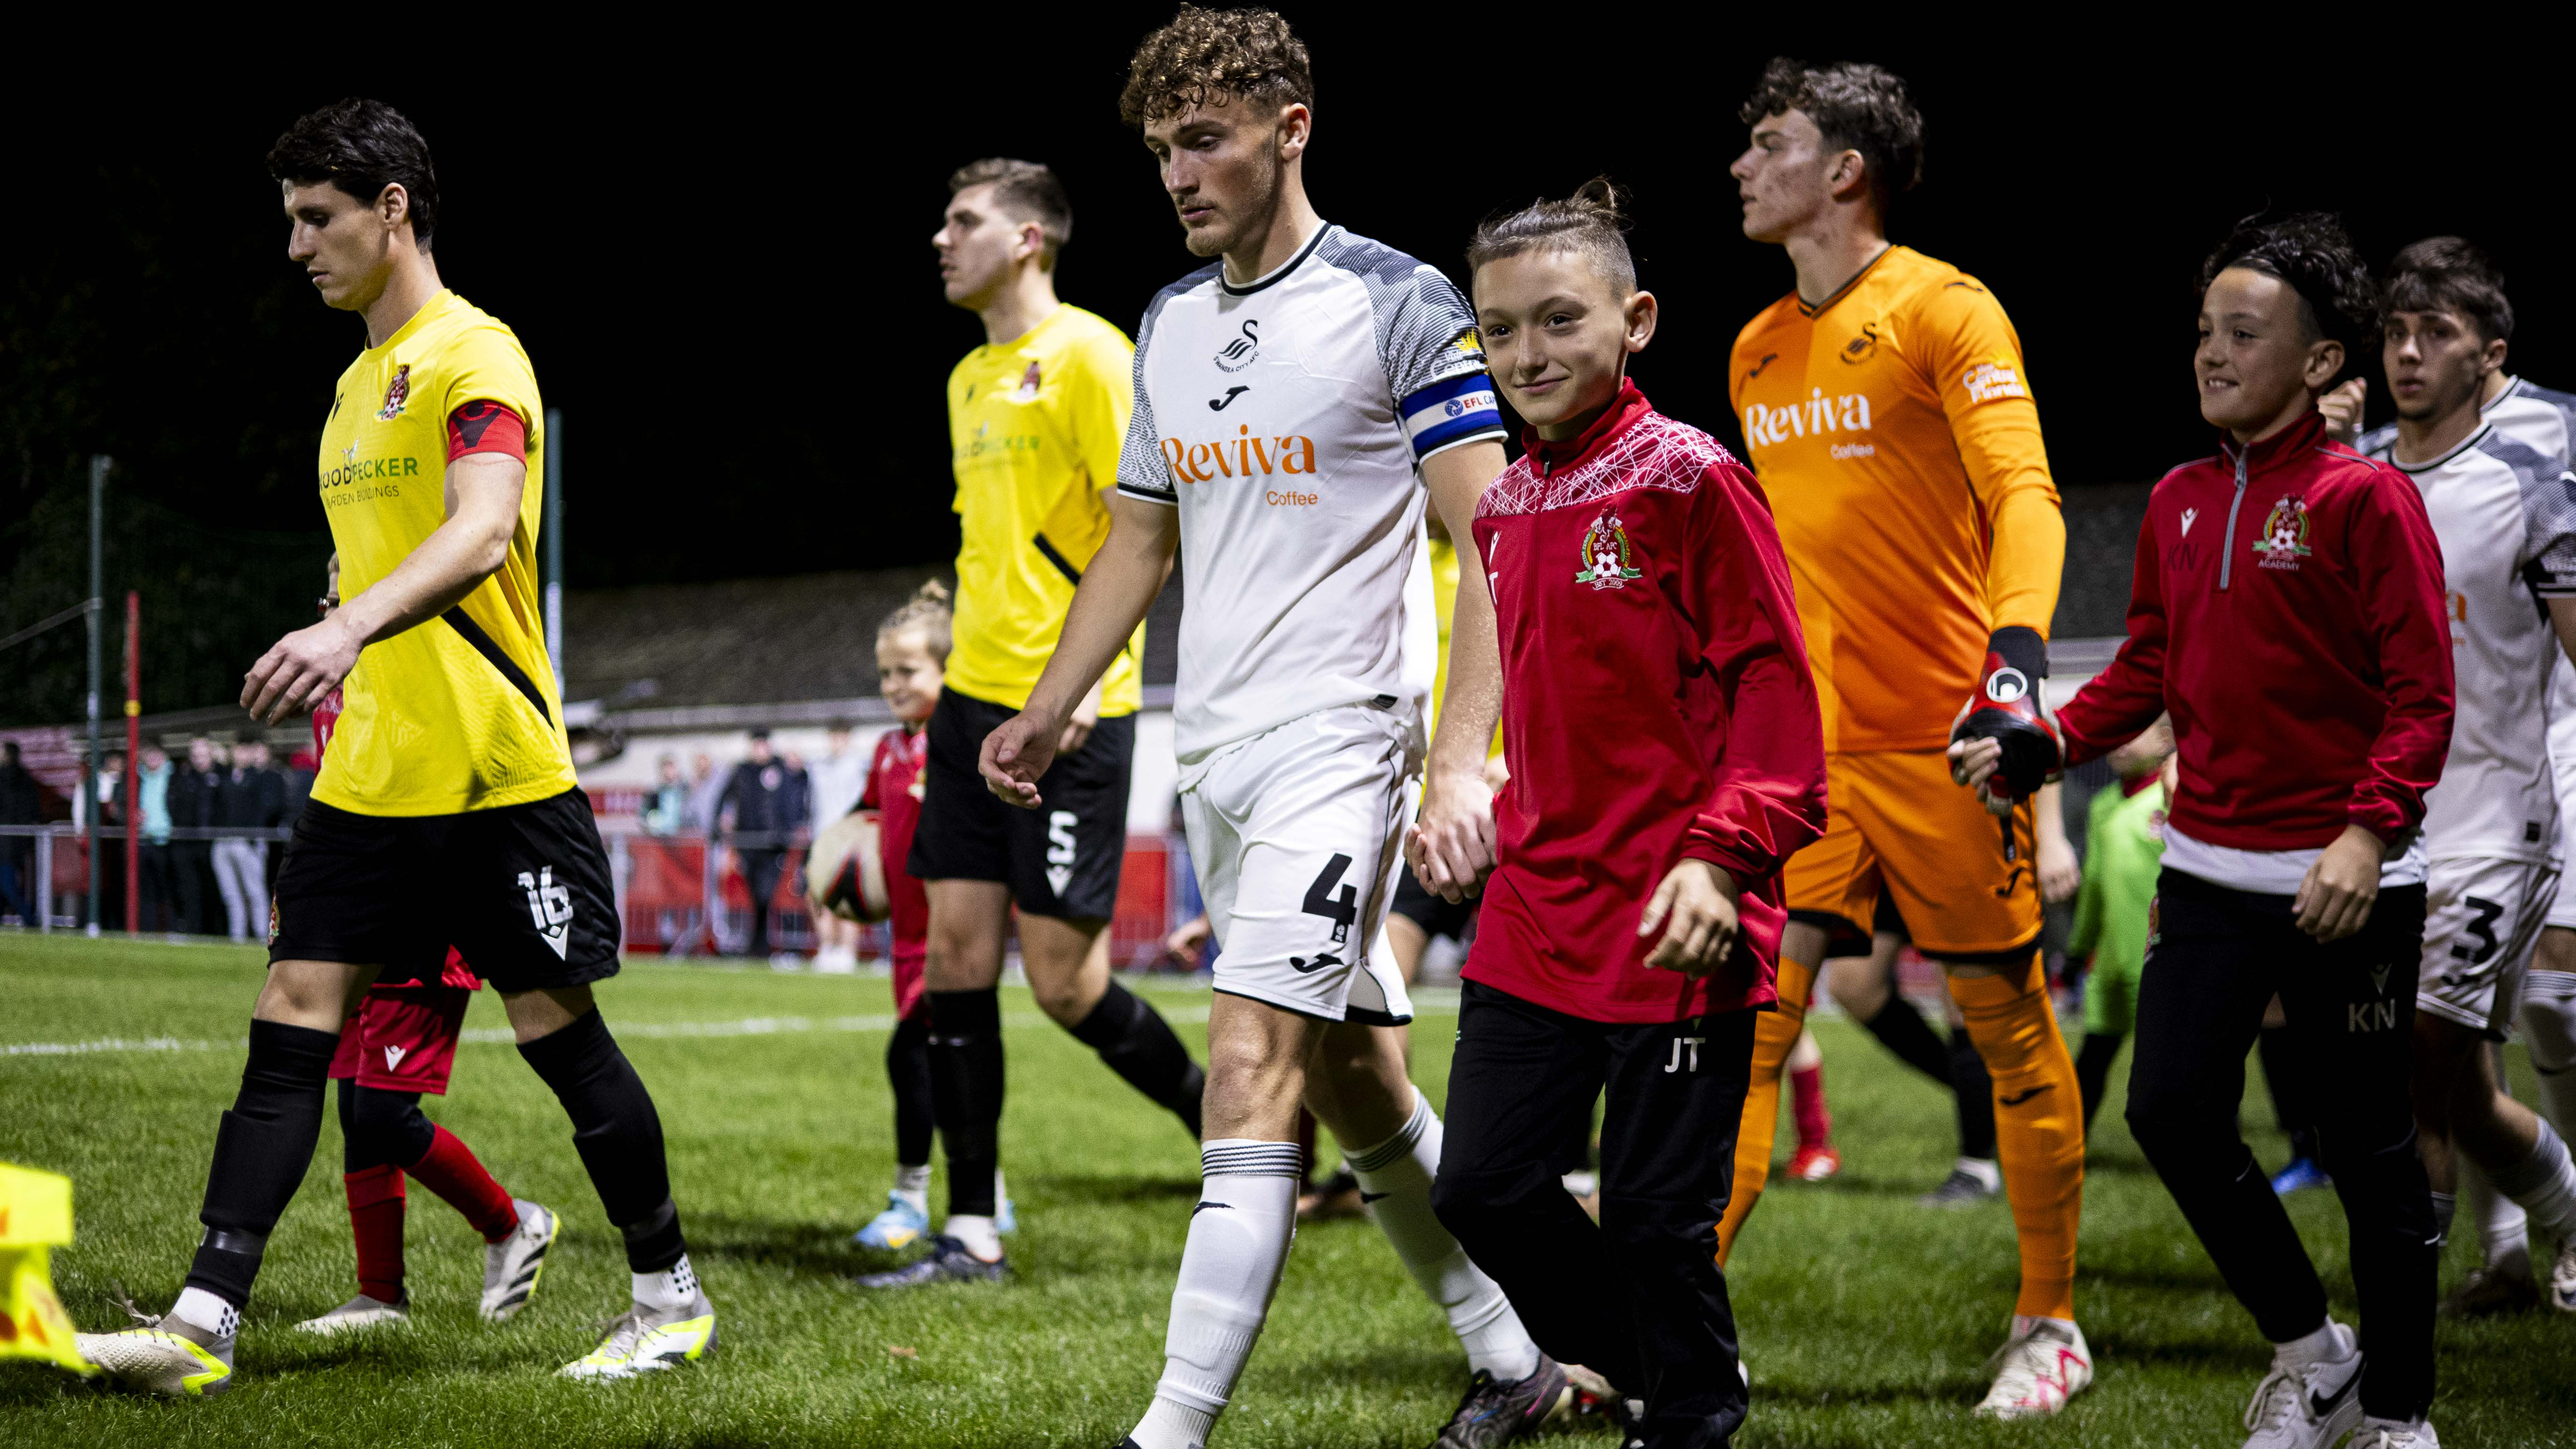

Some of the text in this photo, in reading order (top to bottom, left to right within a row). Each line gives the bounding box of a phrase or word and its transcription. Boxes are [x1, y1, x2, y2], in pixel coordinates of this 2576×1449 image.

[1213, 351, 1259, 372] SWANSEA CITY AFC
[1464, 397, 1482, 408] EFL
[1746, 387, 1872, 451] Reviva
[1161, 424, 1317, 484] Reviva
[1267, 491, 1318, 505] Coffee
[2167, 542, 2199, 571] KN
[1594, 580, 1606, 588] EST
[1046, 810, 1078, 865] 5
[518, 865, 573, 930] 16
[1301, 853, 1358, 943] 4
[2451, 895, 2504, 963] 3
[2349, 998, 2396, 1033] KN
[1665, 1037, 1706, 1073] JT
